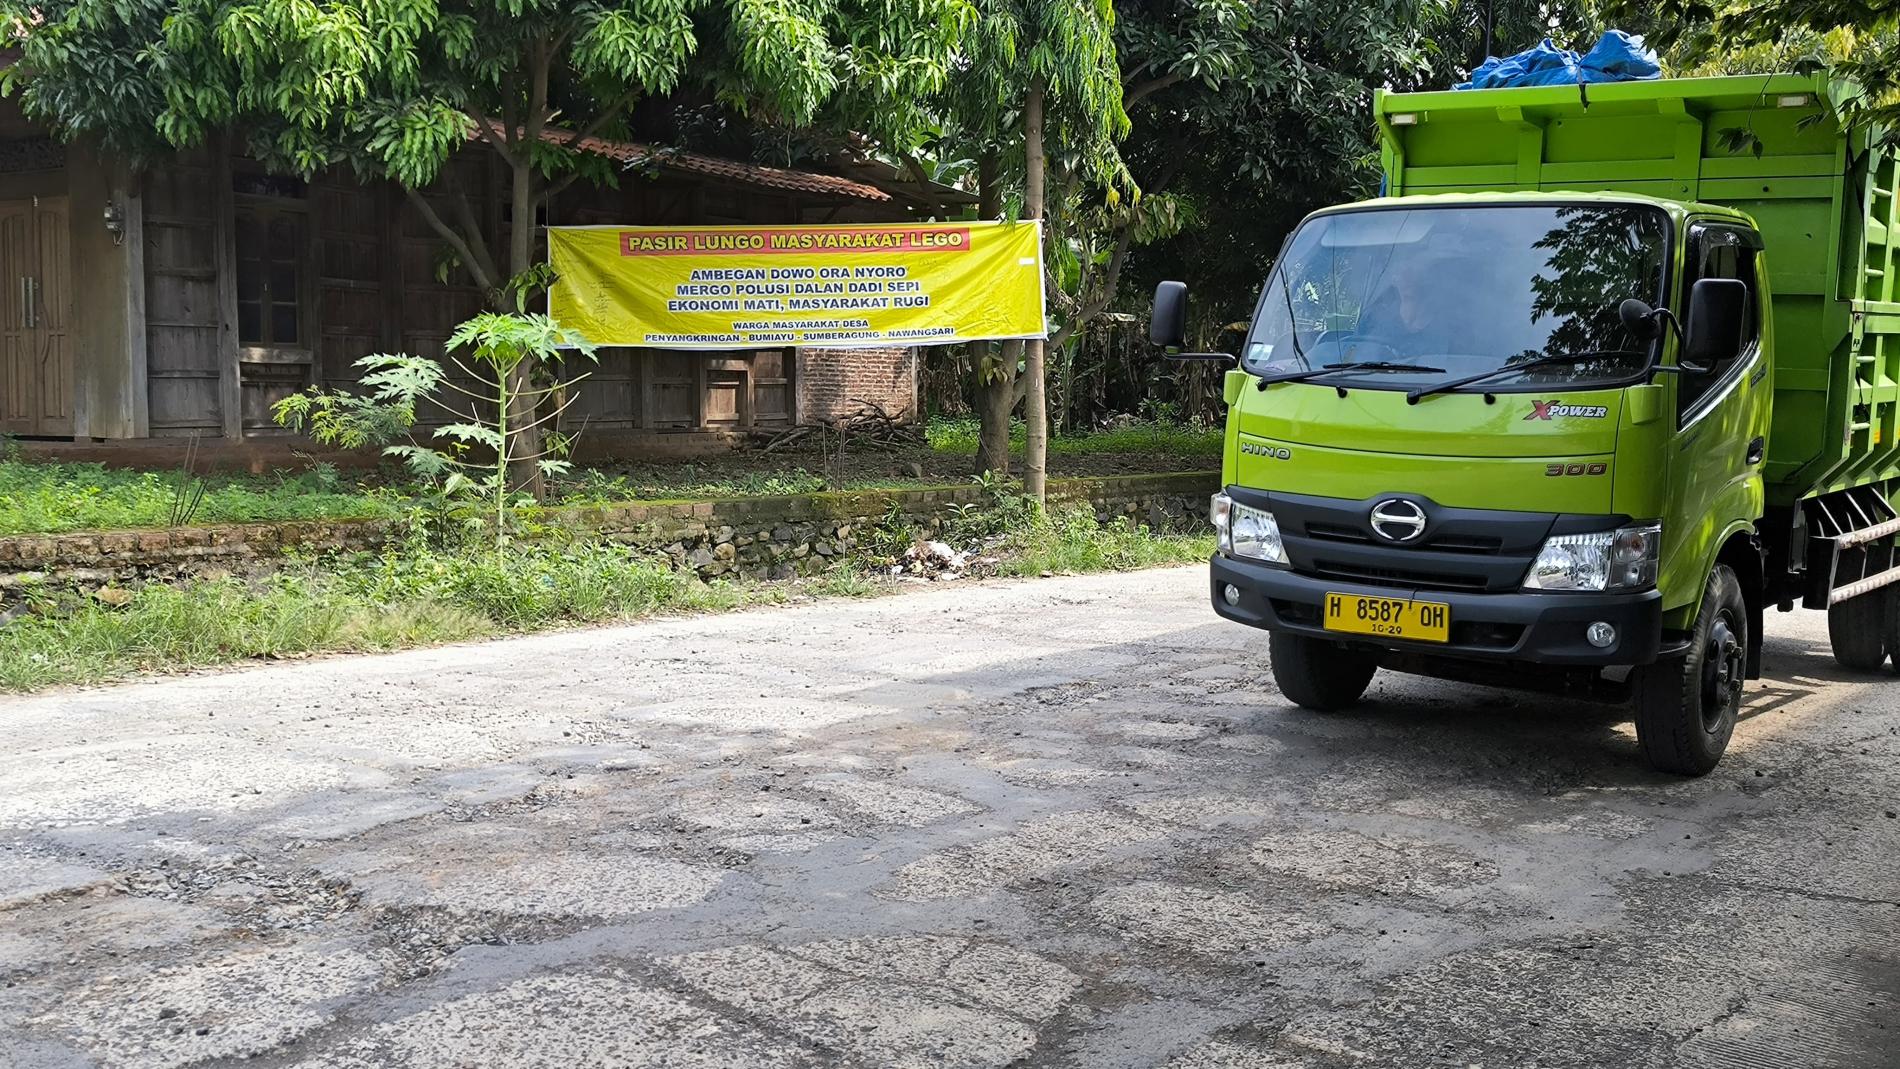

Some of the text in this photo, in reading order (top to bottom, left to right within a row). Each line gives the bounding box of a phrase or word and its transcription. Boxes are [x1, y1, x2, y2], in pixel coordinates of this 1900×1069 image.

[628, 232, 963, 250] PASIR LUNGO MASYARAKAT LEGO
[690, 267, 906, 280] AMBEGAN DOWO ORA NYORO
[677, 281, 920, 295] MERGO POLUSI DALAN DADI SEPI
[668, 296, 929, 312] EKONOMI MATI, MASYARAKAT RUGI
[733, 319, 869, 330] WARGA MASYARAKAT DESA
[645, 334, 740, 342] PENYANGKRINGAN
[749, 333, 794, 342] BUMIAYU
[803, 331, 880, 341] SUMBERAGUNG
[888, 327, 954, 338] NAWANGSARI
[1241, 442, 1290, 460] HINO
[1545, 463, 1608, 477] 300
[1330, 596, 1444, 628] H 8587 OH
